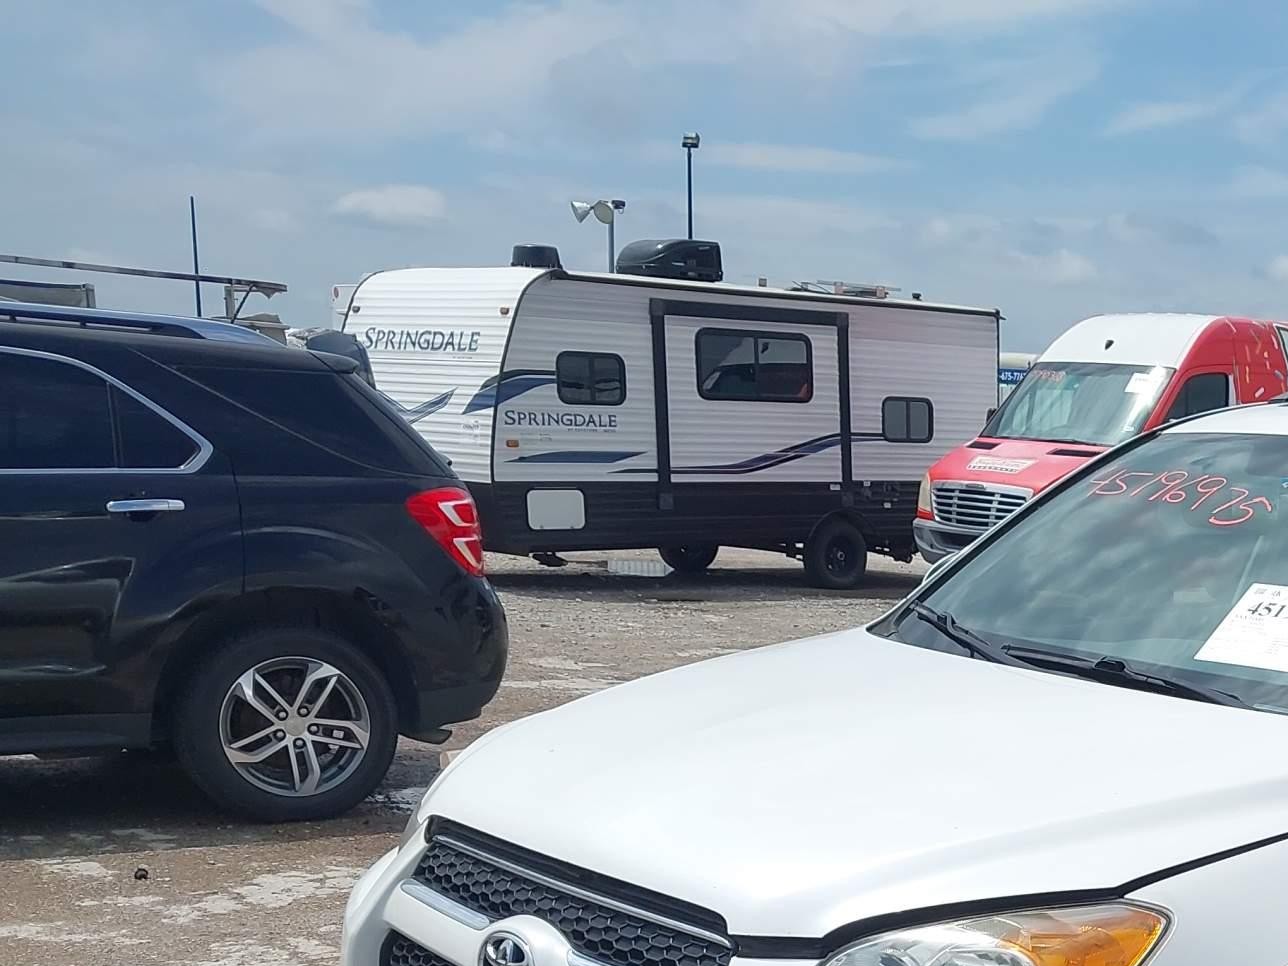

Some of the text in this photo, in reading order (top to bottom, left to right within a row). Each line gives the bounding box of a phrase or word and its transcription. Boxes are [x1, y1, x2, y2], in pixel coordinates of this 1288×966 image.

[365, 326, 481, 352] SPRINGDALE
[504, 409, 618, 428] SPRINGDALE
[1087, 469, 1273, 526] 45196975
